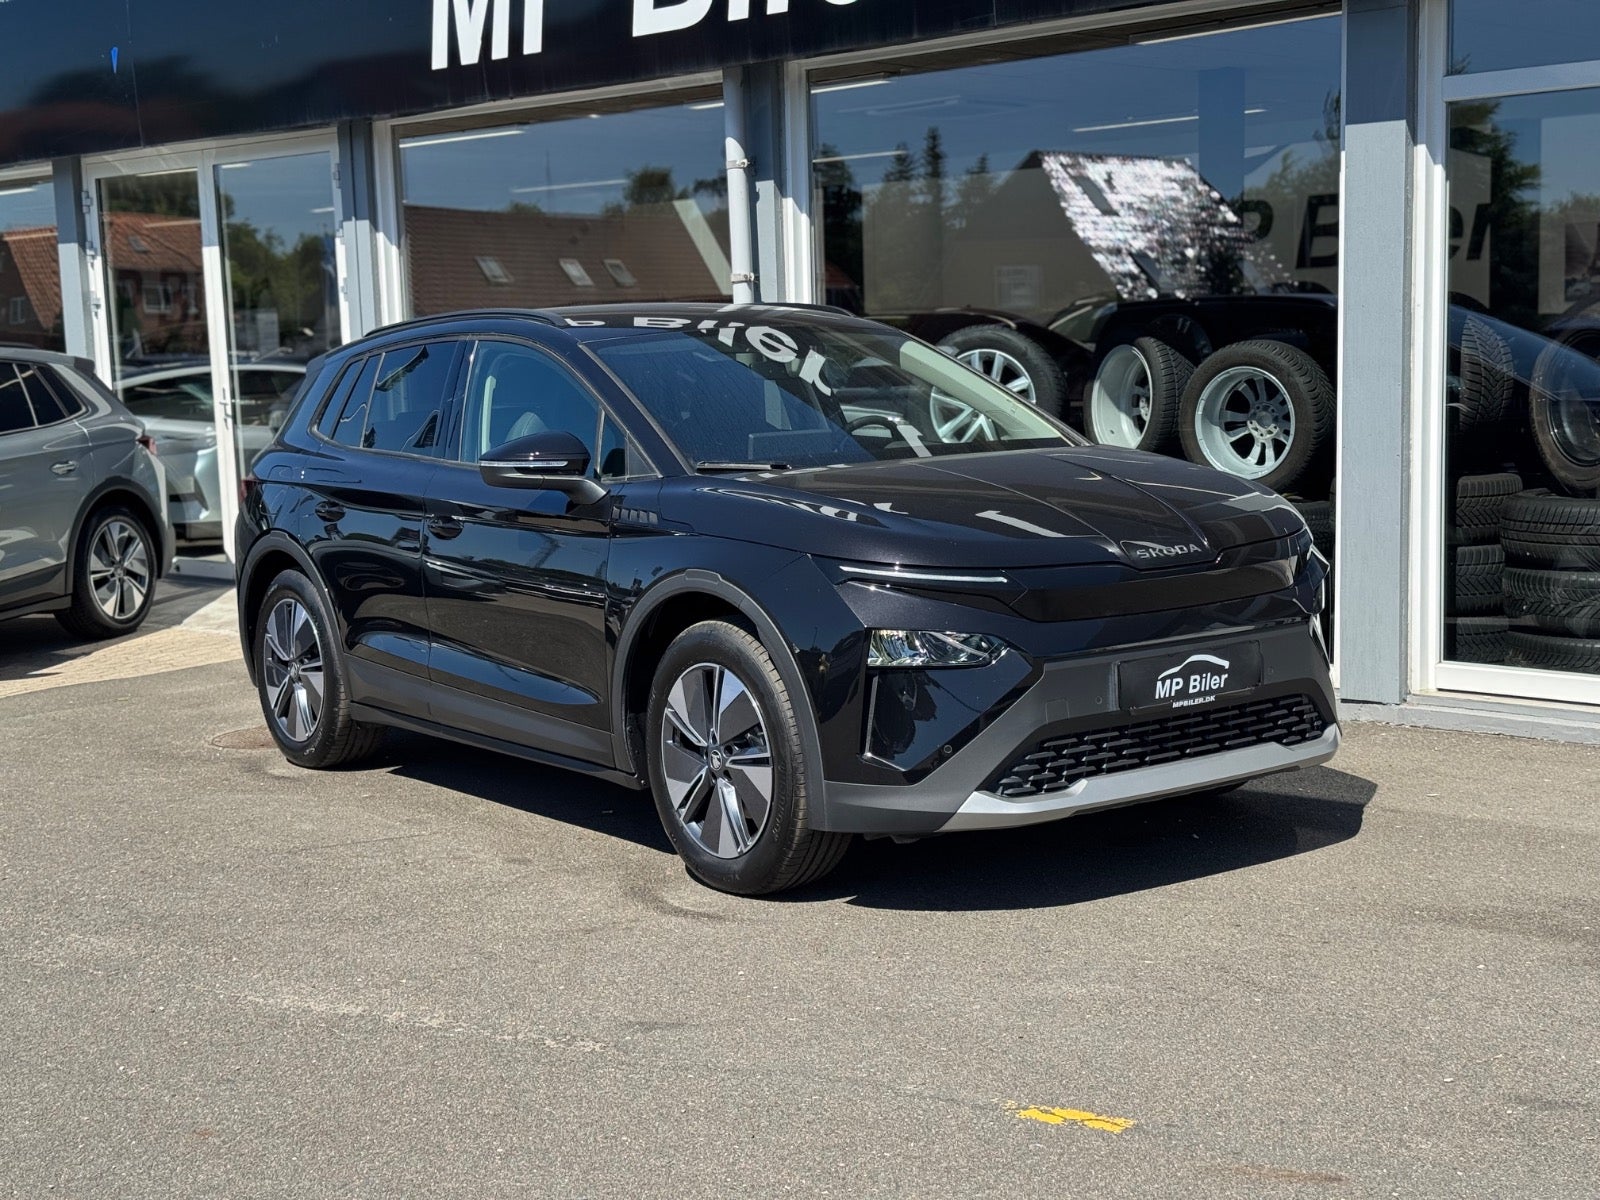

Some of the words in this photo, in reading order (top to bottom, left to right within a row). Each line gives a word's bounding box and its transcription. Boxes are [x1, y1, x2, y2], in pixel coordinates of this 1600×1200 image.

[1155, 677, 1184, 700] MP
[1188, 672, 1229, 694] Biler
[1172, 695, 1216, 709] MPBILER.DK
